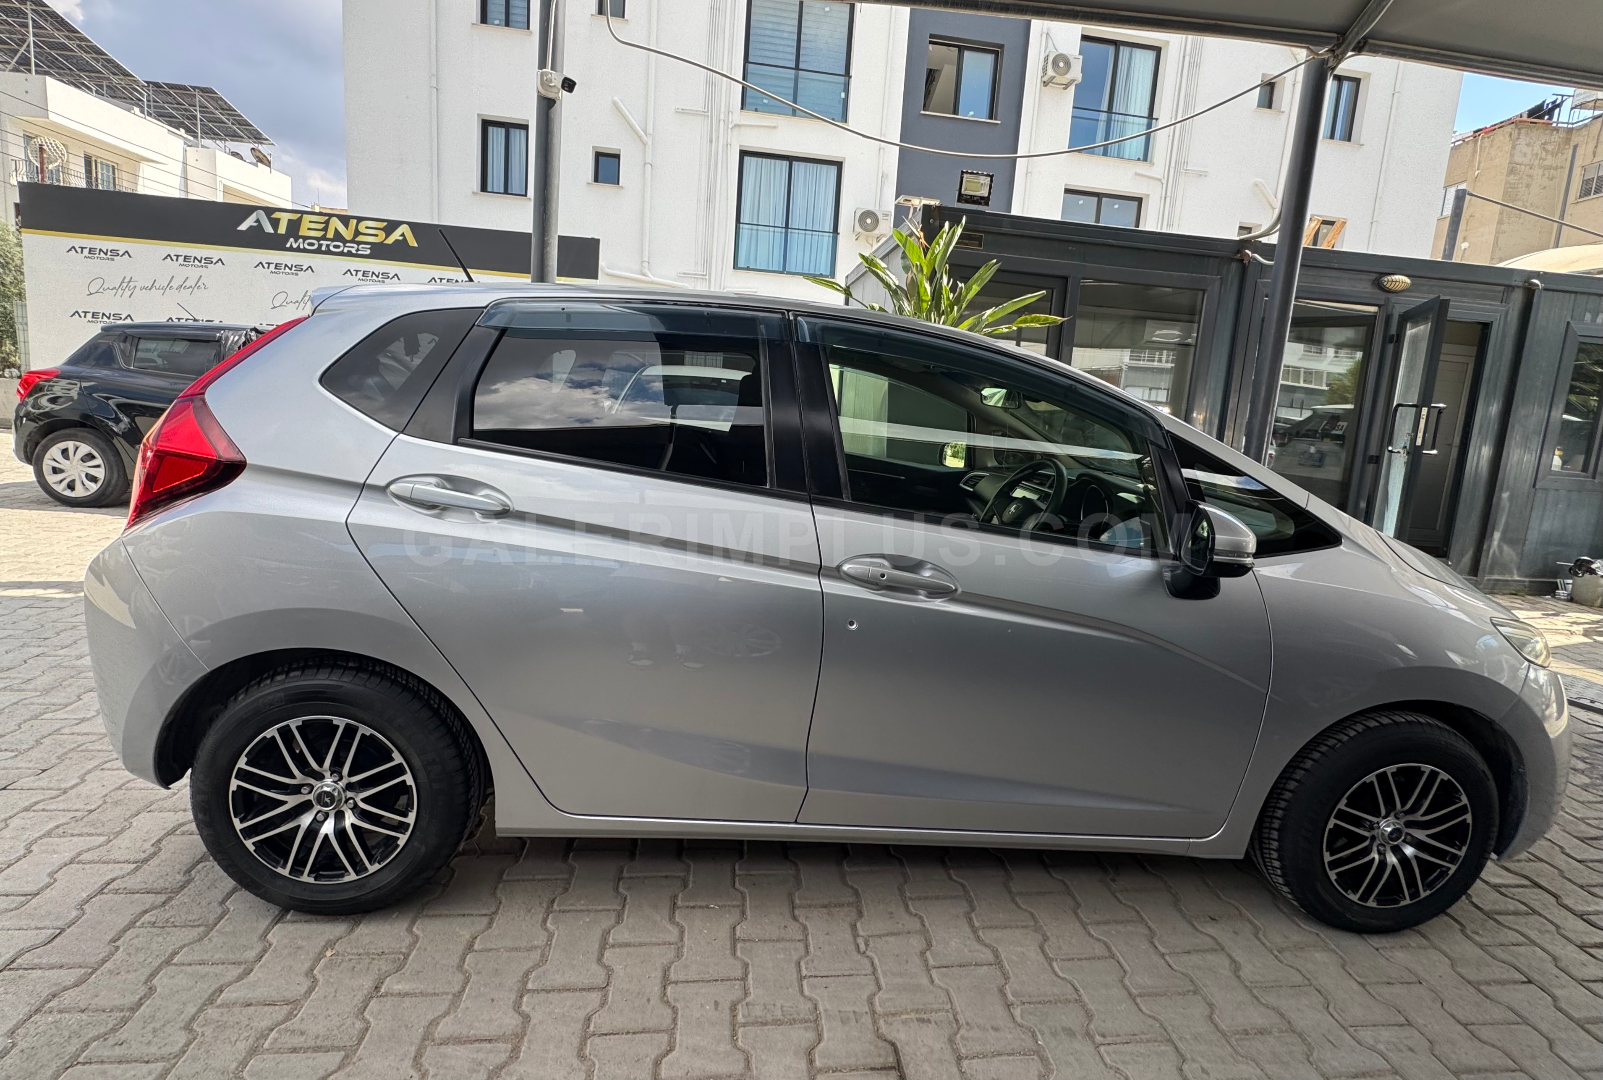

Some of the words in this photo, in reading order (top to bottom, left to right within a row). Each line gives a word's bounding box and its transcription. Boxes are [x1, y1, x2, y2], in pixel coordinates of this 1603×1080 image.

[236, 209, 418, 247] ATENSA
[66, 245, 132, 259] ATENSA
[285, 237, 372, 255] MOTORS
[162, 253, 225, 266] ATENSA
[253, 261, 315, 274] ATENSA
[342, 268, 401, 281] ATENSA
[86, 275, 138, 299] Quality
[140, 275, 174, 297] vehicle
[175, 274, 209, 296] dealer
[69, 310, 134, 322] ATENSA
